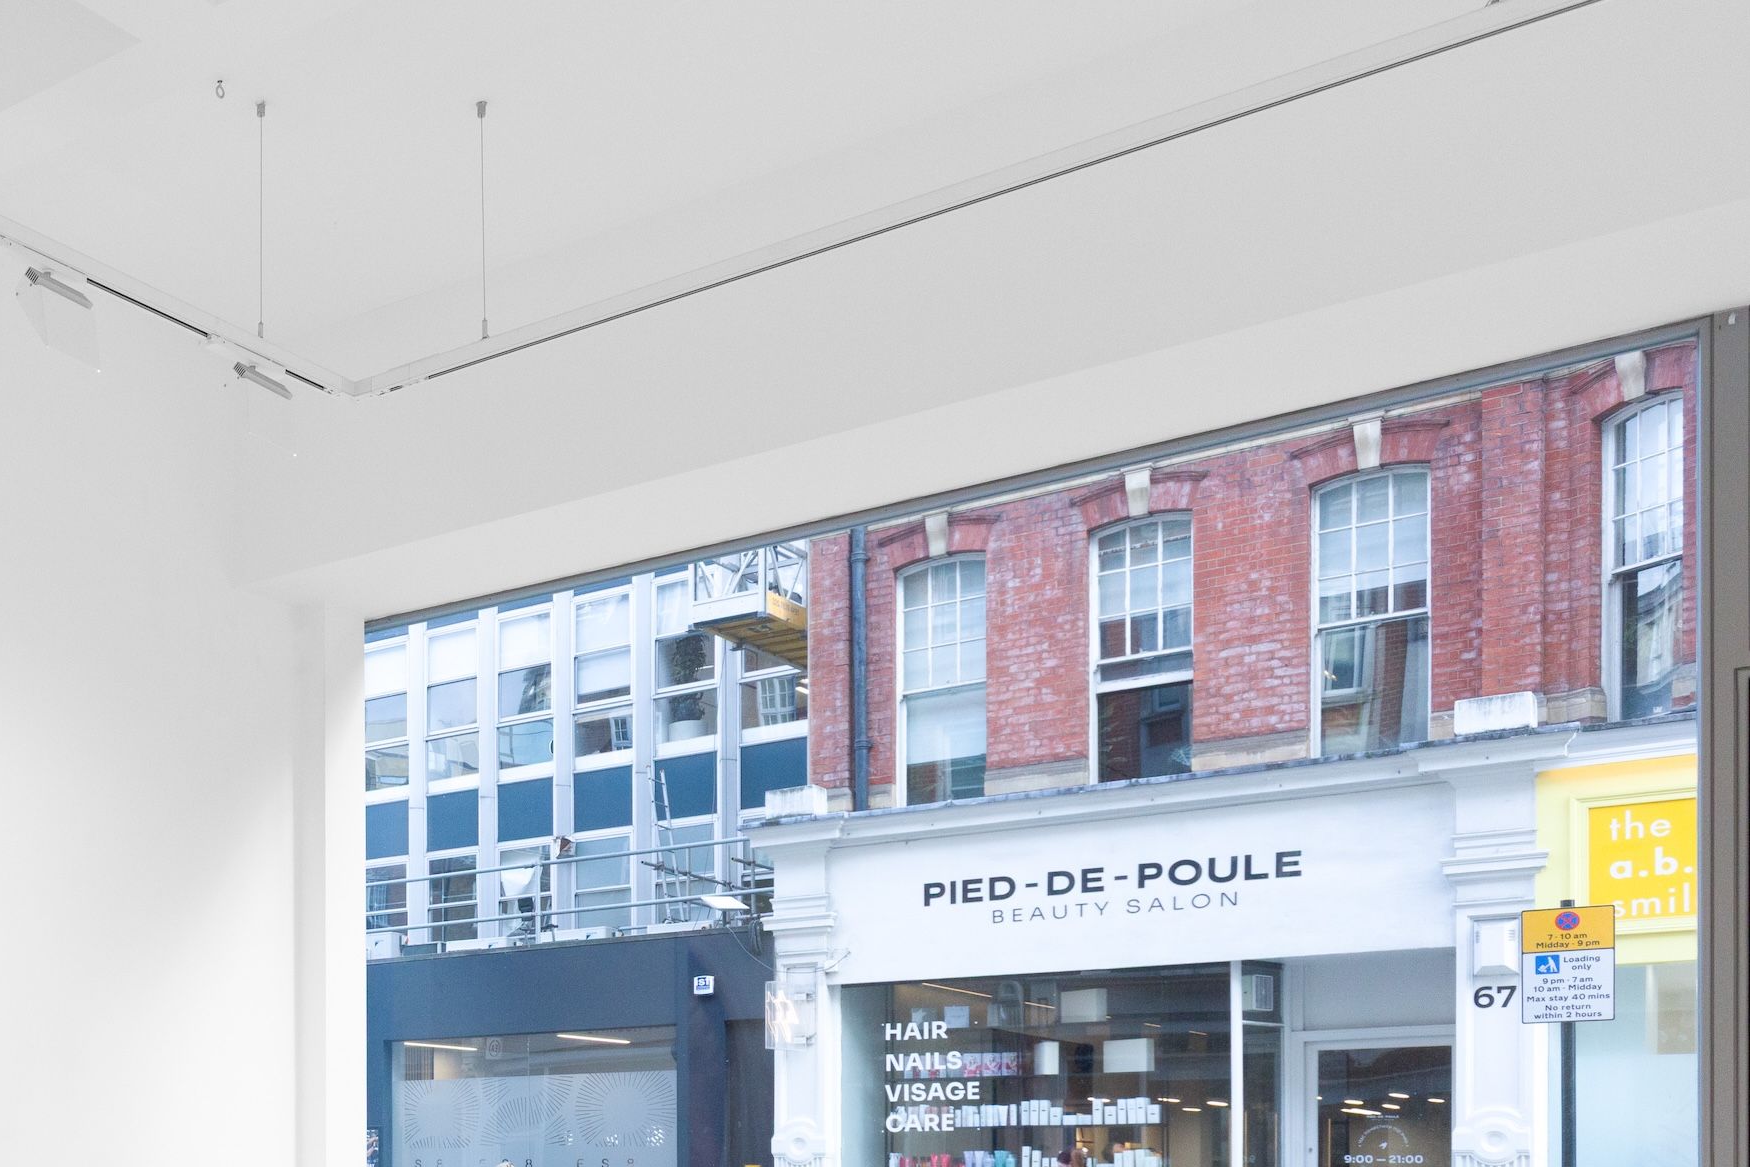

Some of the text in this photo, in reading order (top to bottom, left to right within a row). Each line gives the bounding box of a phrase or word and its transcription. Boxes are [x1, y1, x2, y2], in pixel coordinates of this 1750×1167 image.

[1609, 809, 1672, 841] the
[923, 850, 1303, 908] PIED-DE-POULE
[991, 891, 1240, 925] BEAUTY SALON
[1536, 941, 1570, 949] Midday
[1563, 955, 1601, 963] Loading
[1571, 963, 1592, 971] only
[1473, 985, 1518, 1009] 67
[885, 1020, 949, 1041] HAIR
[885, 1050, 963, 1072] NAILS
[885, 1081, 981, 1103] VISAGE
[885, 1112, 954, 1134] CARE
[1343, 1154, 1374, 1164] 9:00
[1388, 1154, 1424, 1164] 21:00
